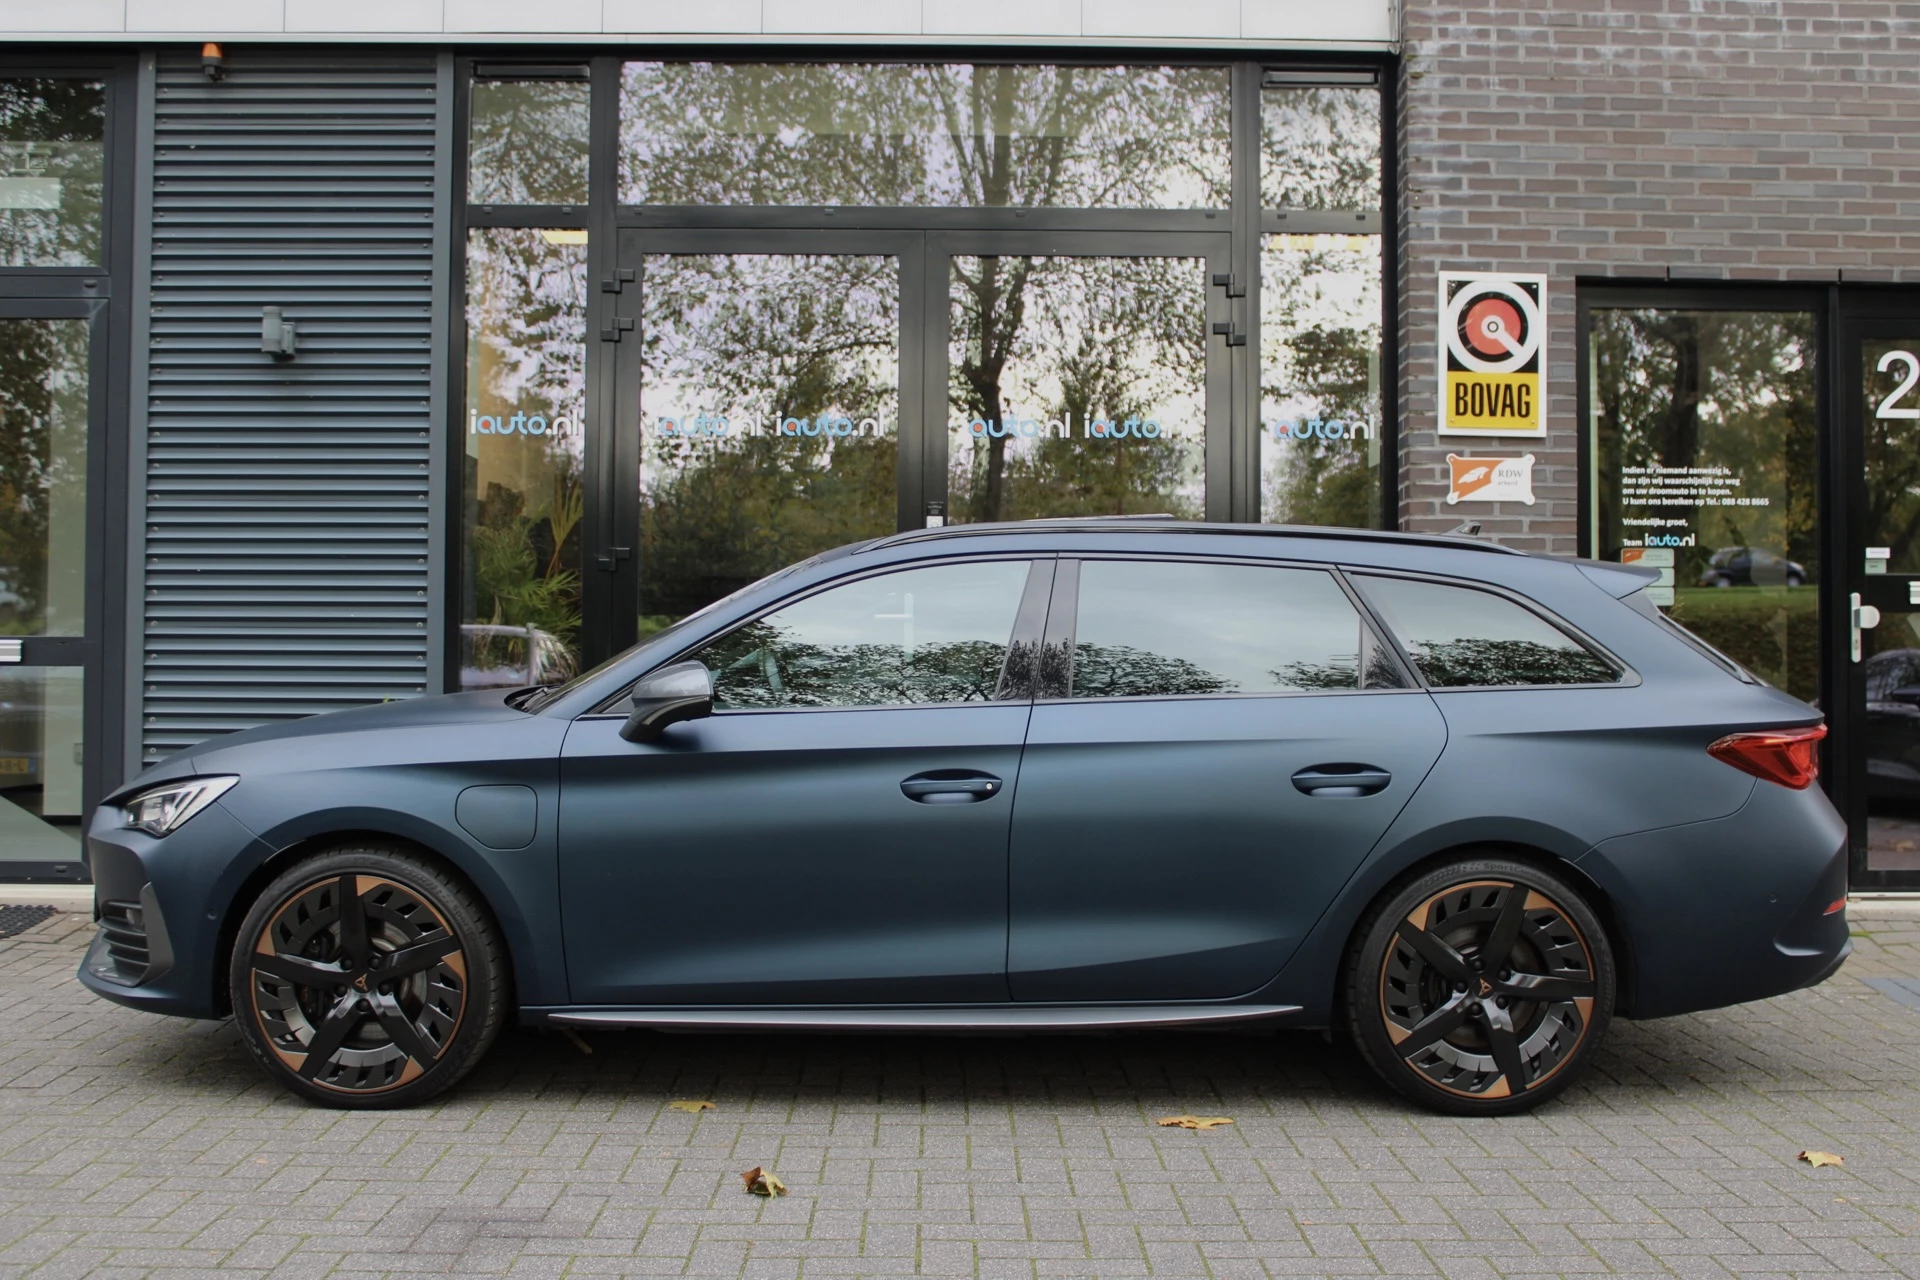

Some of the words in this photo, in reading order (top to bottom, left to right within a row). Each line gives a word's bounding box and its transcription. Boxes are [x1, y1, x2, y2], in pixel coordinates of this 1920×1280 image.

[1876, 349, 1920, 419] 2
[1454, 382, 1531, 418] BOVAG
[470, 408, 579, 435] iauto.nl
[776, 410, 884, 437] iauto.nl
[1269, 413, 1375, 440] auto.nl
[1498, 469, 1523, 478] RDW
[1622, 466, 1646, 474] Indien
[1656, 466, 1687, 474] niemand
[1688, 466, 1722, 476] aanwezig
[1622, 476, 1637, 484] dan
[1637, 476, 1650, 486] zijn
[1651, 476, 1663, 486] wij
[1664, 476, 1713, 486] waarschijnlijk
[1713, 478, 1724, 486] op
[1725, 478, 1741, 486] weg
[1648, 486, 1689, 495] droomauto
[1690, 487, 1697, 495] in
[1698, 487, 1707, 495] te
[1707, 487, 1732, 497] kopen.
[1622, 497, 1629, 505] U
[1630, 497, 1647, 505] kunt
[1662, 497, 1694, 505] bereiken
[1694, 498, 1705, 507] op
[1622, 518, 1666, 527] Vriendelijke
[1666, 518, 1688, 527] groet,
[1622, 538, 1643, 546] Team
[1644, 532, 1696, 547] iauto.nl
